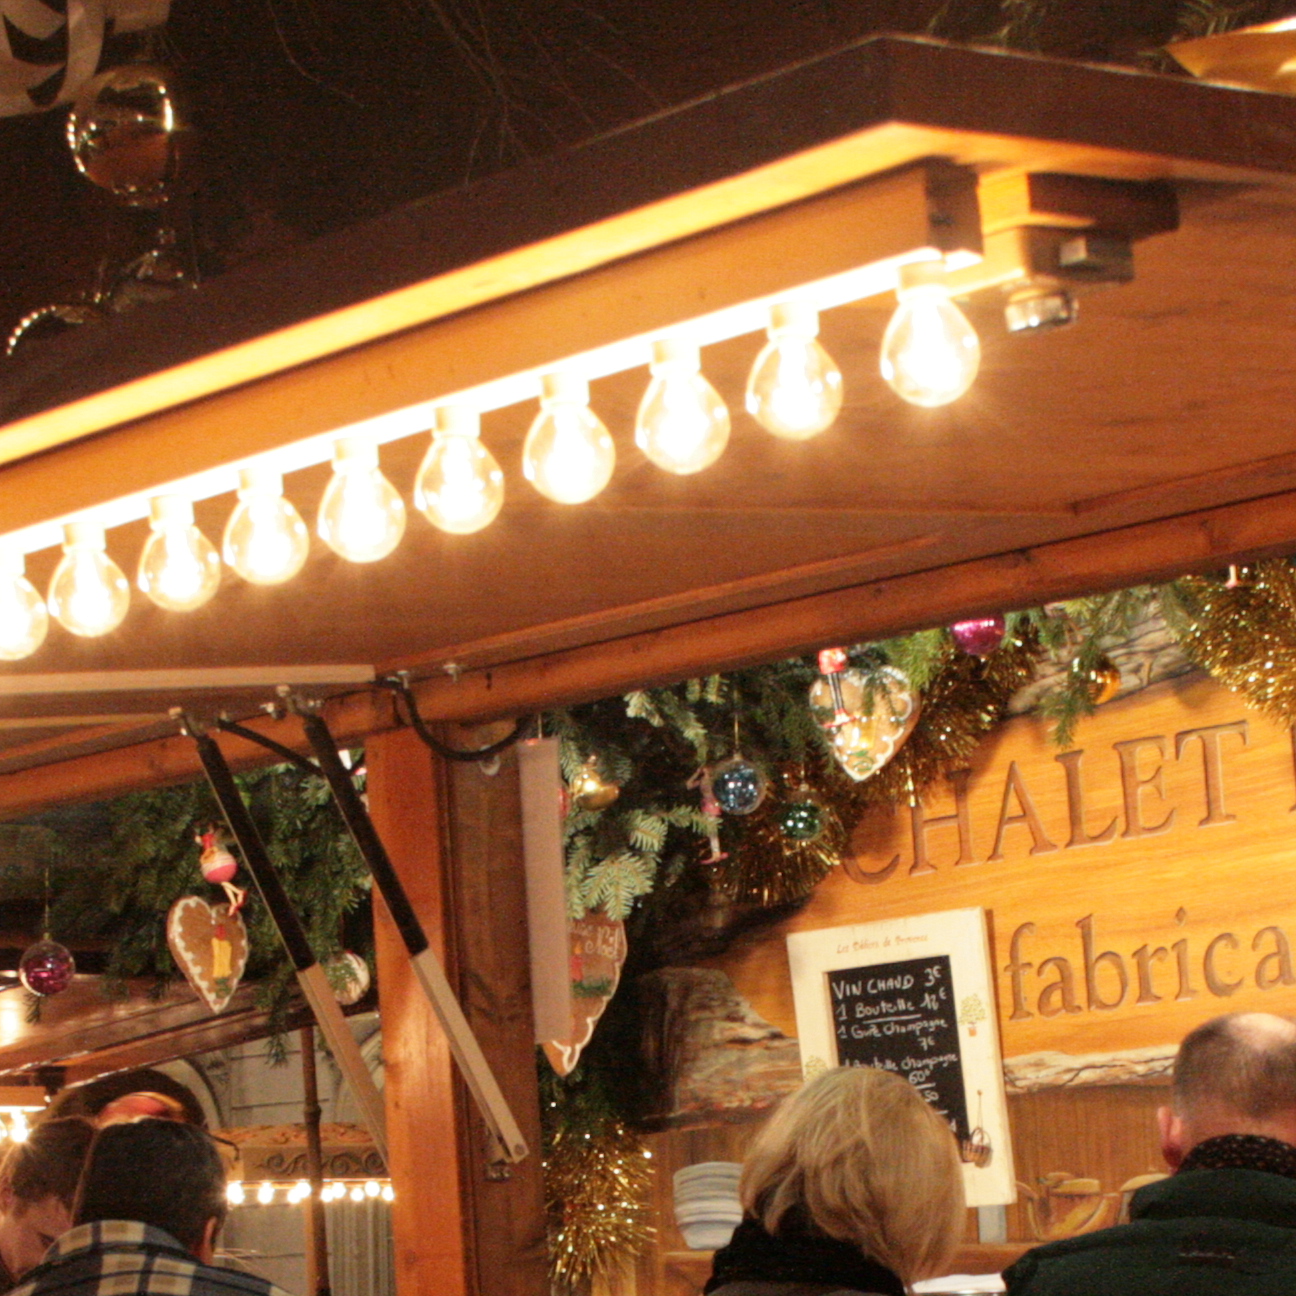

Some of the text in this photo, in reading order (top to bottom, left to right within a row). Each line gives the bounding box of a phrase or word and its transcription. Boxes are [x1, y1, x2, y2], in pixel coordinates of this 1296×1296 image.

[832, 980, 862, 1000] VIN
[924, 965, 942, 987] 3€
[835, 1003, 848, 1020] 1
[837, 1024, 848, 1039] 1
